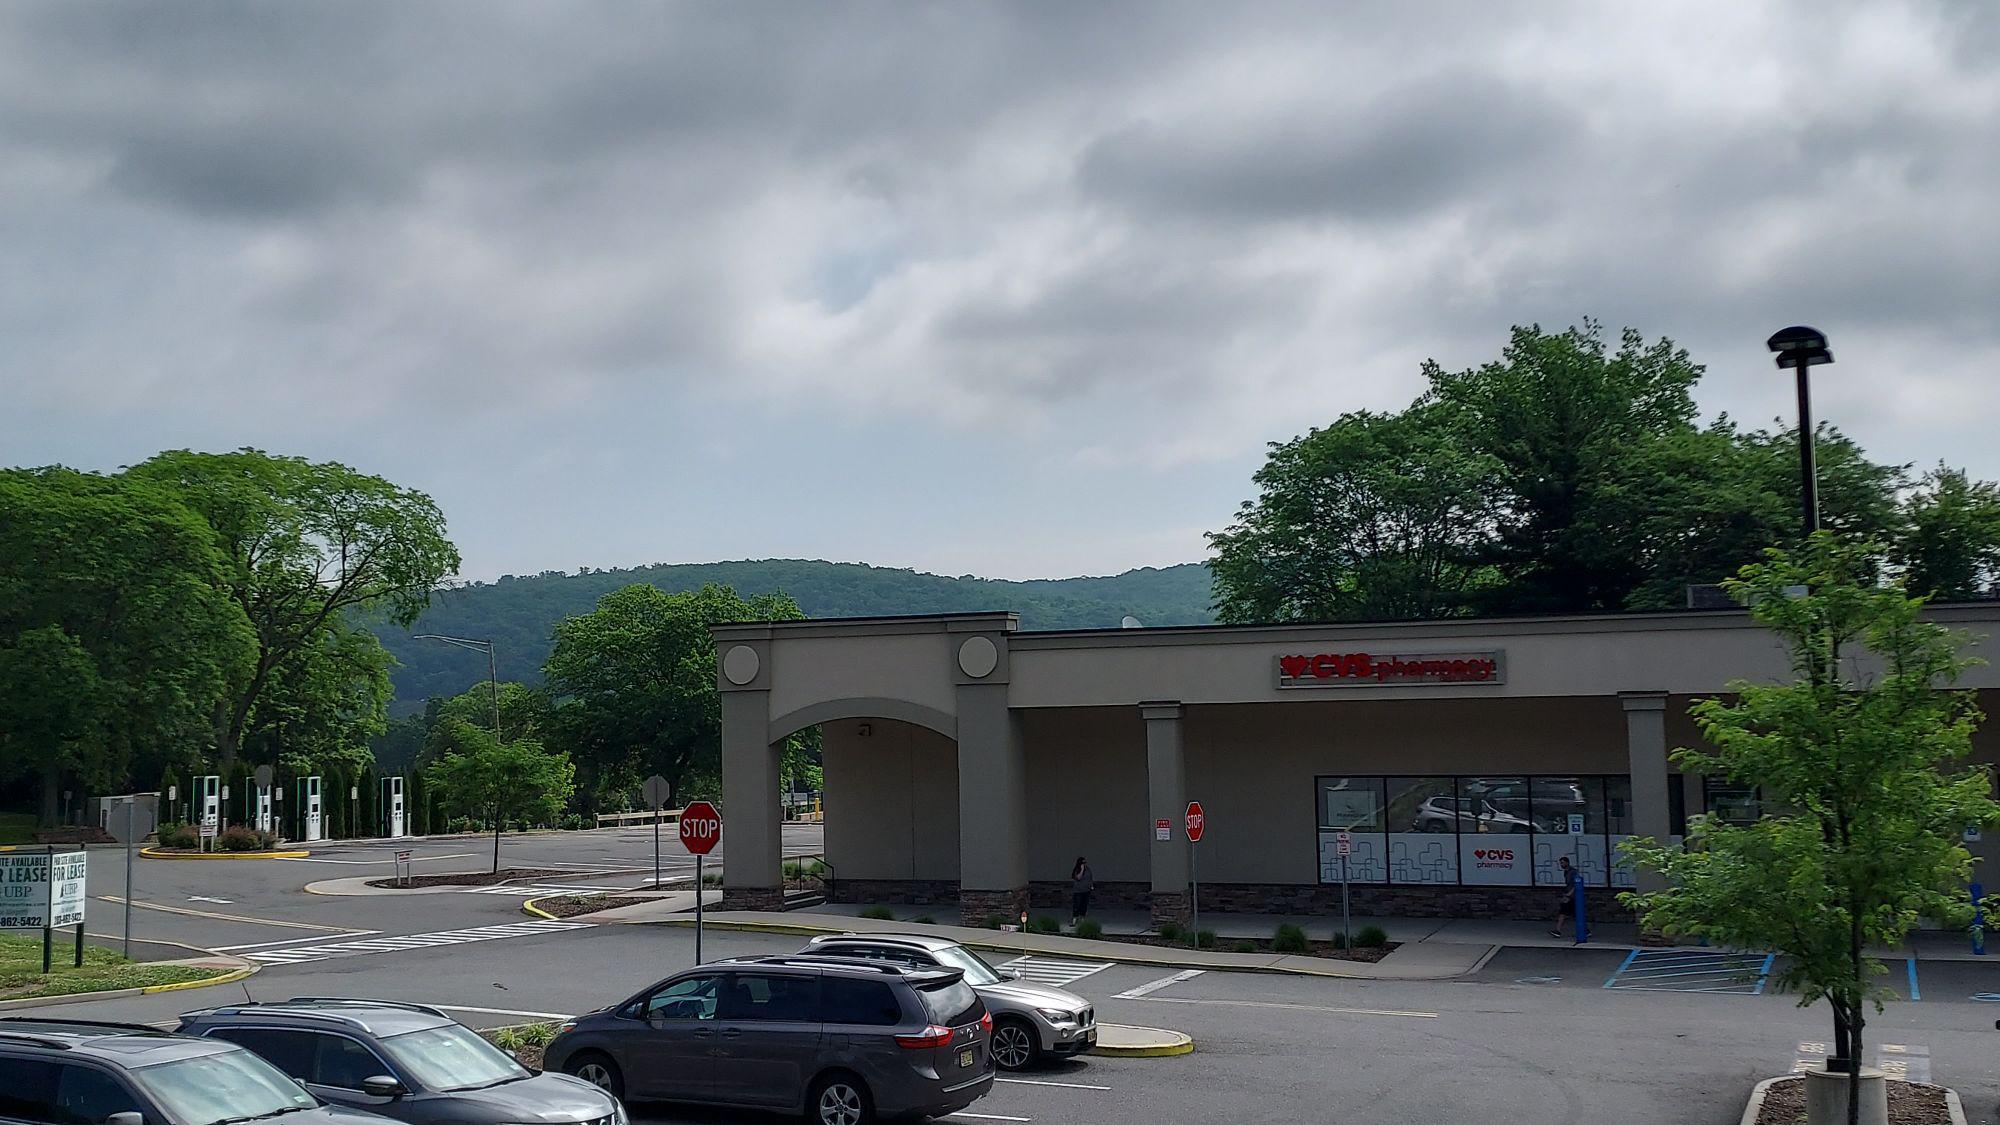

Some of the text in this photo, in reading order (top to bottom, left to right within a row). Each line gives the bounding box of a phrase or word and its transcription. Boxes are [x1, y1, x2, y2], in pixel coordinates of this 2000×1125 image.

[1310, 653, 1495, 681] CVS pharmacy
[682, 818, 718, 838] STOP
[1187, 814, 1202, 829] STOP
[11, 856, 47, 867] AVAILABLE
[1487, 849, 1514, 861] CVS
[53, 864, 85, 881] FOR LEASE
[1477, 862, 1513, 870] pharmacy
[9, 867, 47, 882] LEASE
[4, 886, 32, 897] UBP
